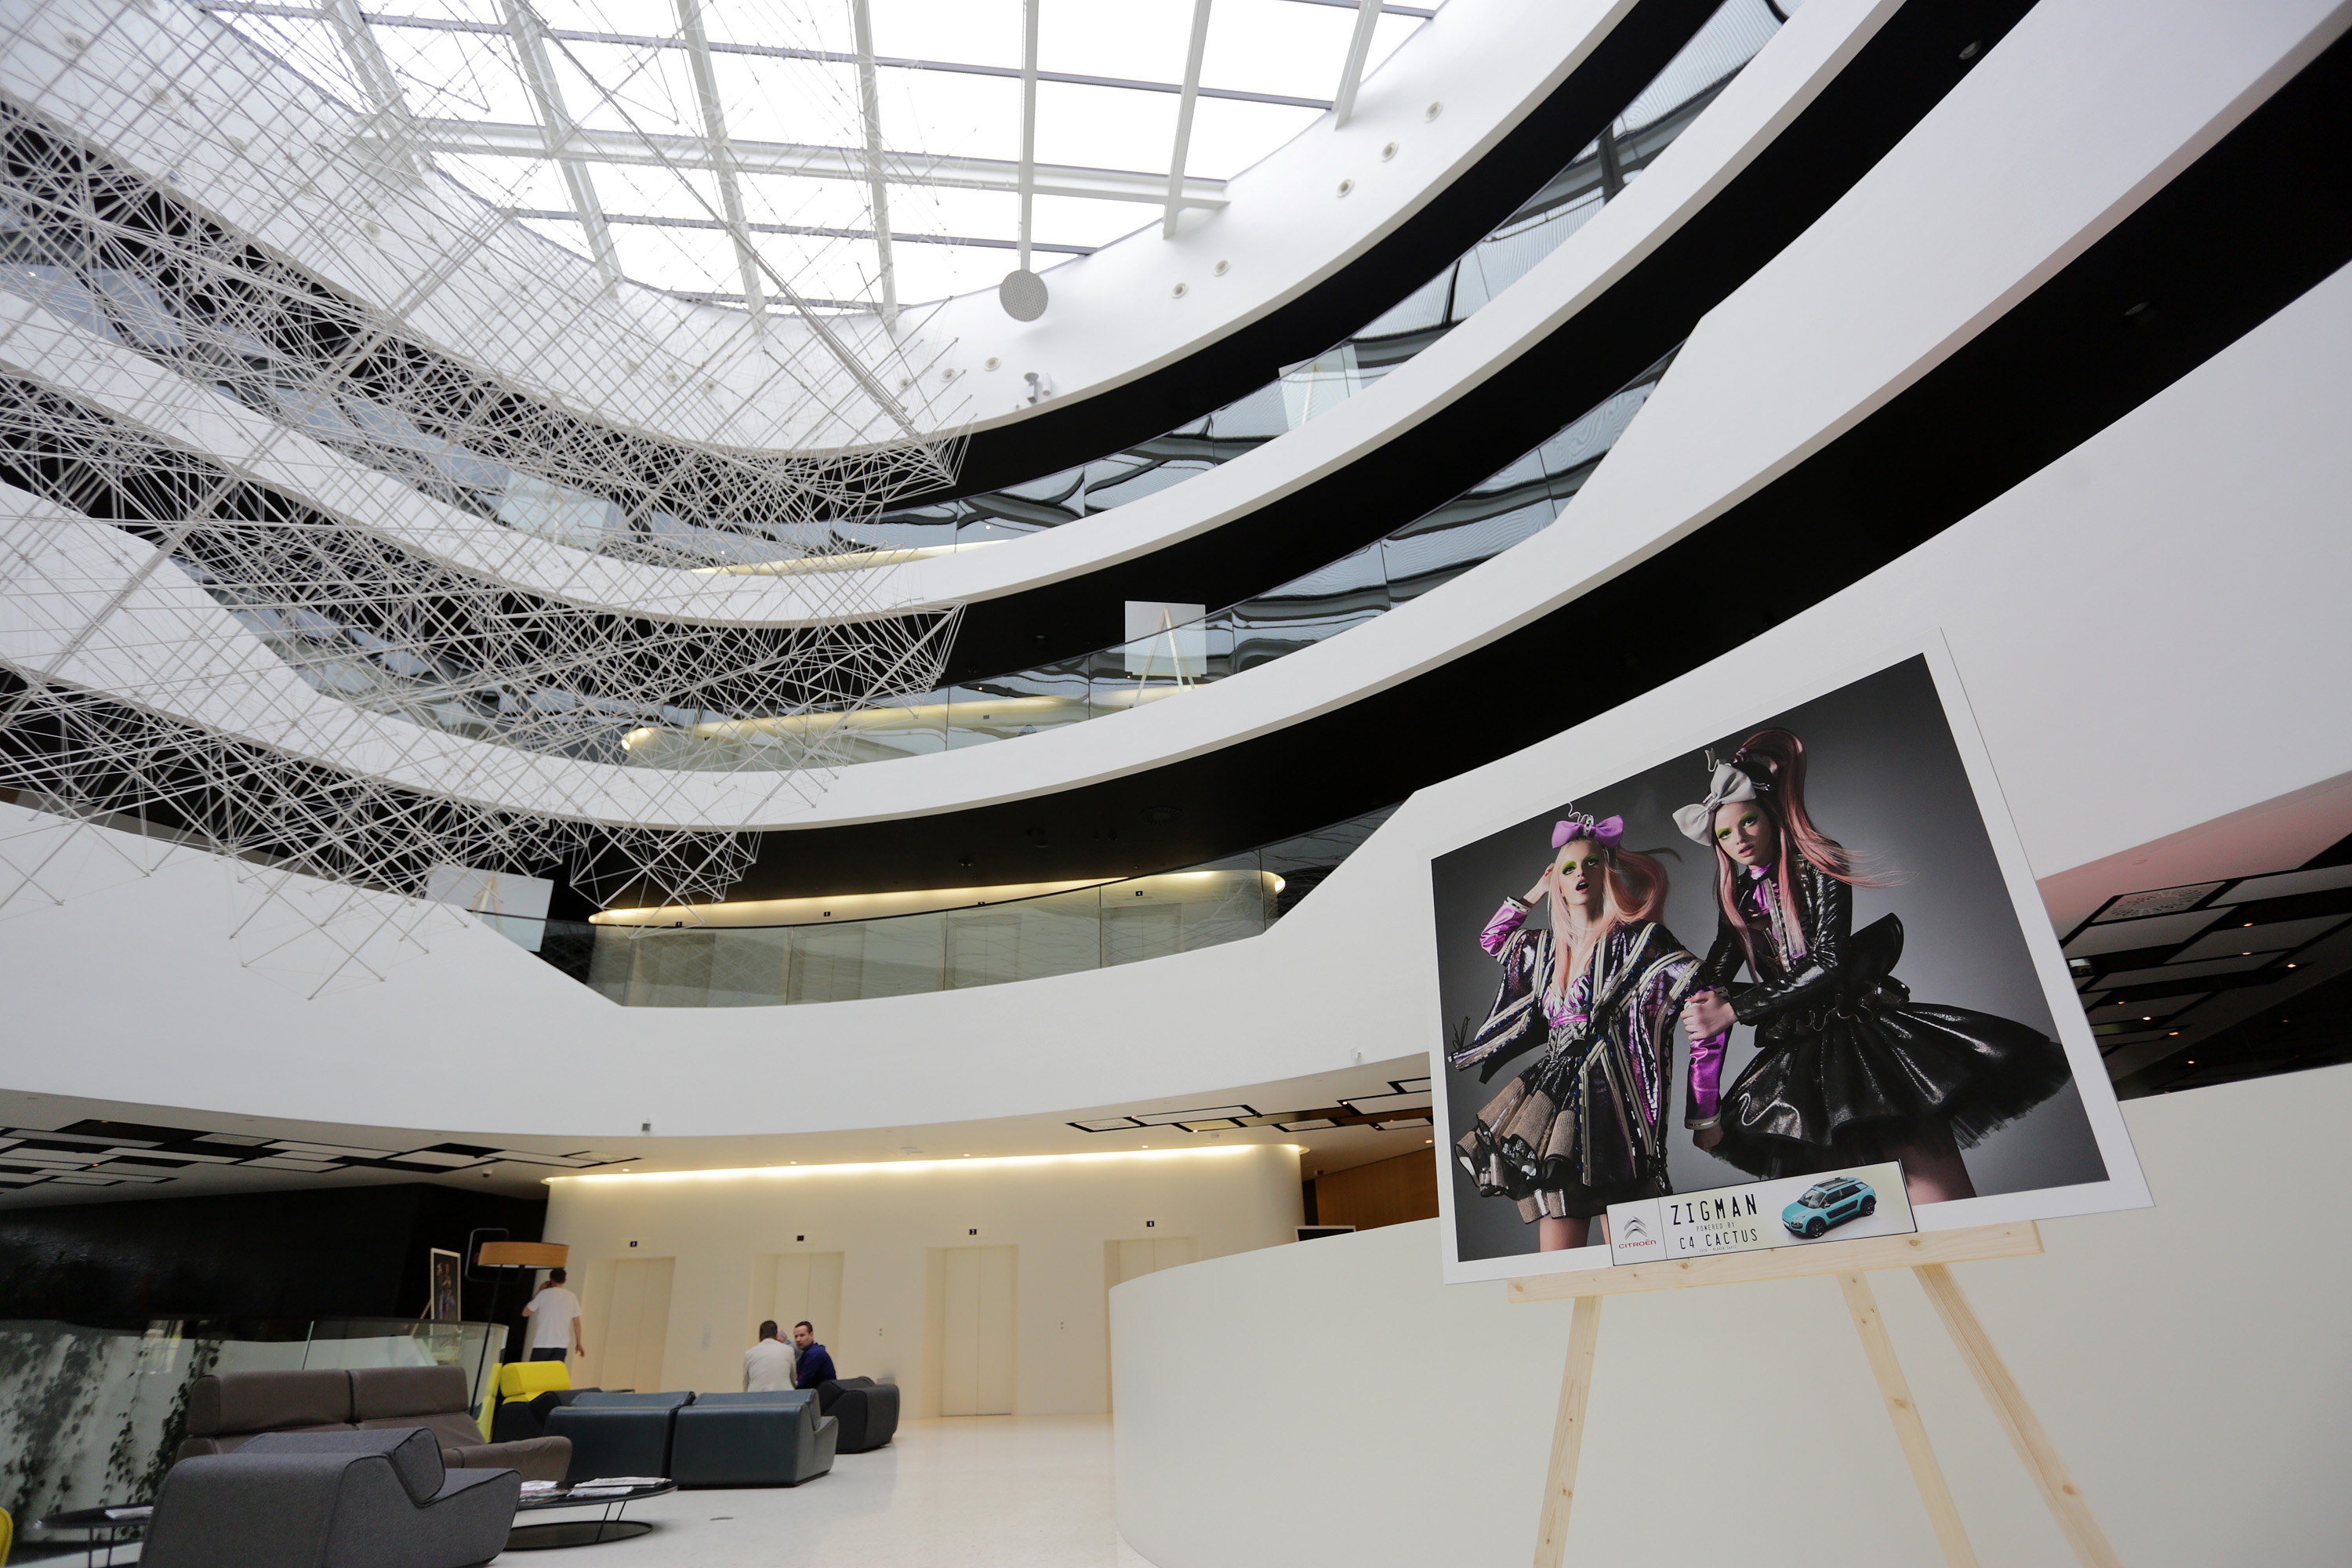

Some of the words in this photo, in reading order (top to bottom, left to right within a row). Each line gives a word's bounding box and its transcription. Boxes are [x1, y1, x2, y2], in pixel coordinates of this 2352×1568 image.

[1670, 1193, 1758, 1225] ZIGMAN
[1696, 1223, 1723, 1232] POWERED
[1679, 1236, 1694, 1249] C4
[1705, 1228, 1758, 1247] CACTUS
